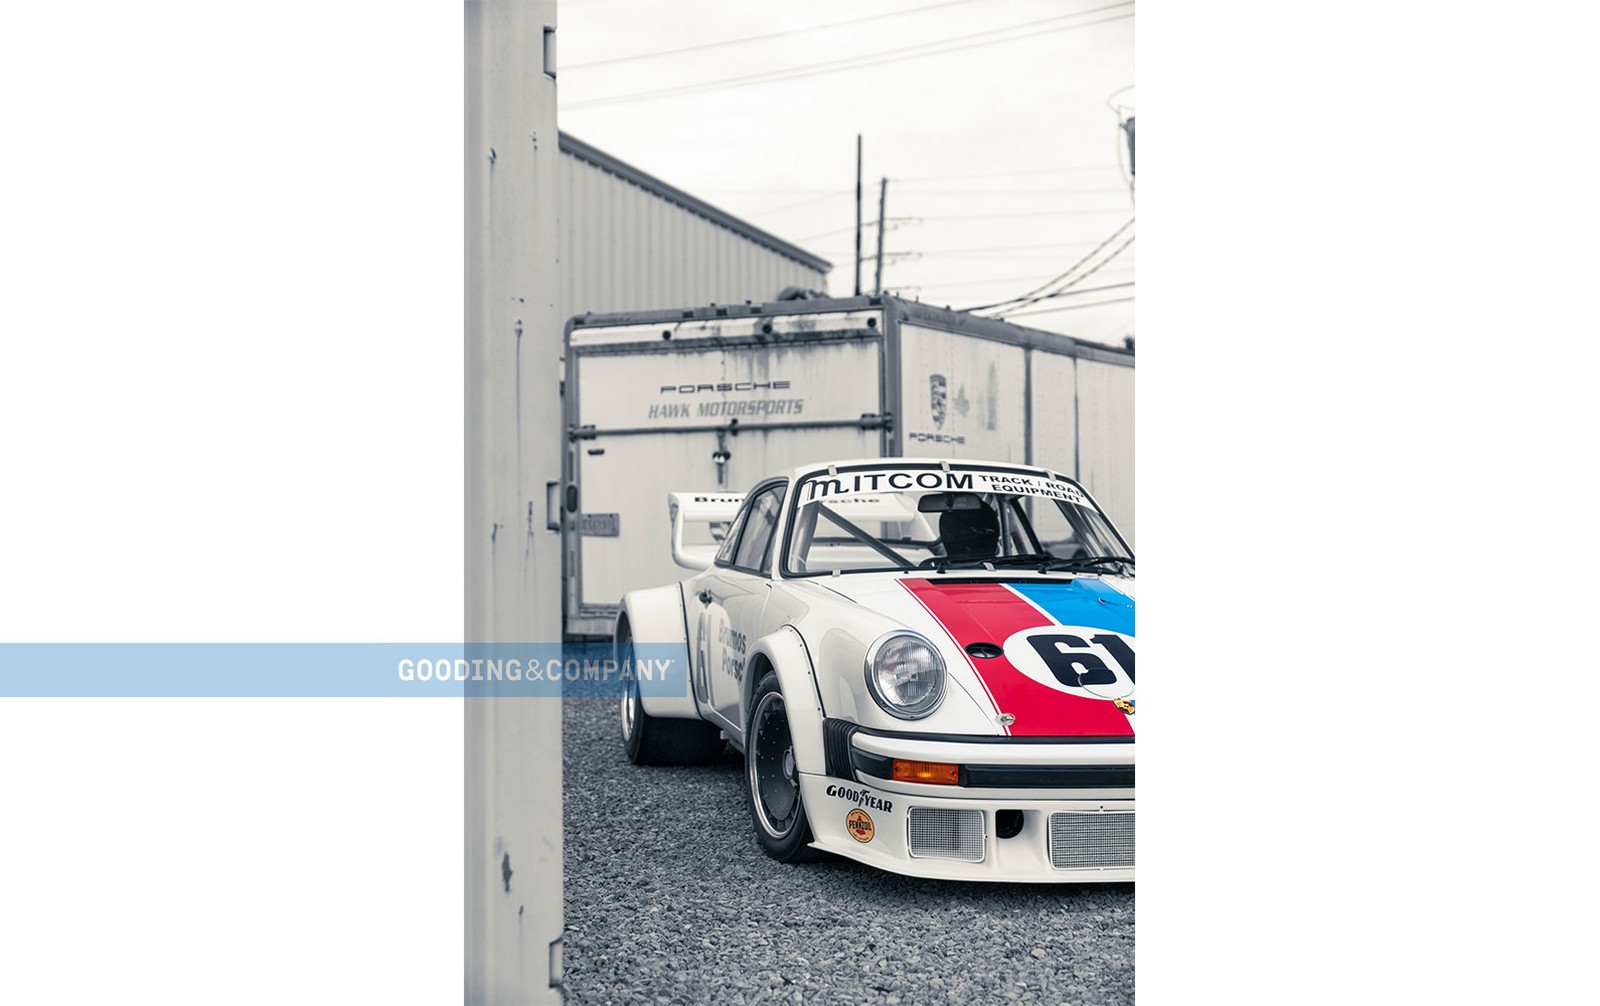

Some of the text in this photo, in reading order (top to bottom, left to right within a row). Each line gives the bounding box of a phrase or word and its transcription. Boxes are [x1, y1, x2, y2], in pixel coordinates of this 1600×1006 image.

[660, 381, 790, 394] PORSCHE
[648, 399, 804, 419] HAWK MOTORSPORTS
[909, 432, 965, 445] PORSCHE
[978, 475, 1033, 486] TRACK
[1045, 482, 1084, 498] ROAD
[991, 484, 1081, 503] EQUIPMENT
[721, 647, 746, 682] Porsc
[1026, 633, 1135, 688] 61
[826, 785, 893, 813] GOODYEAR
